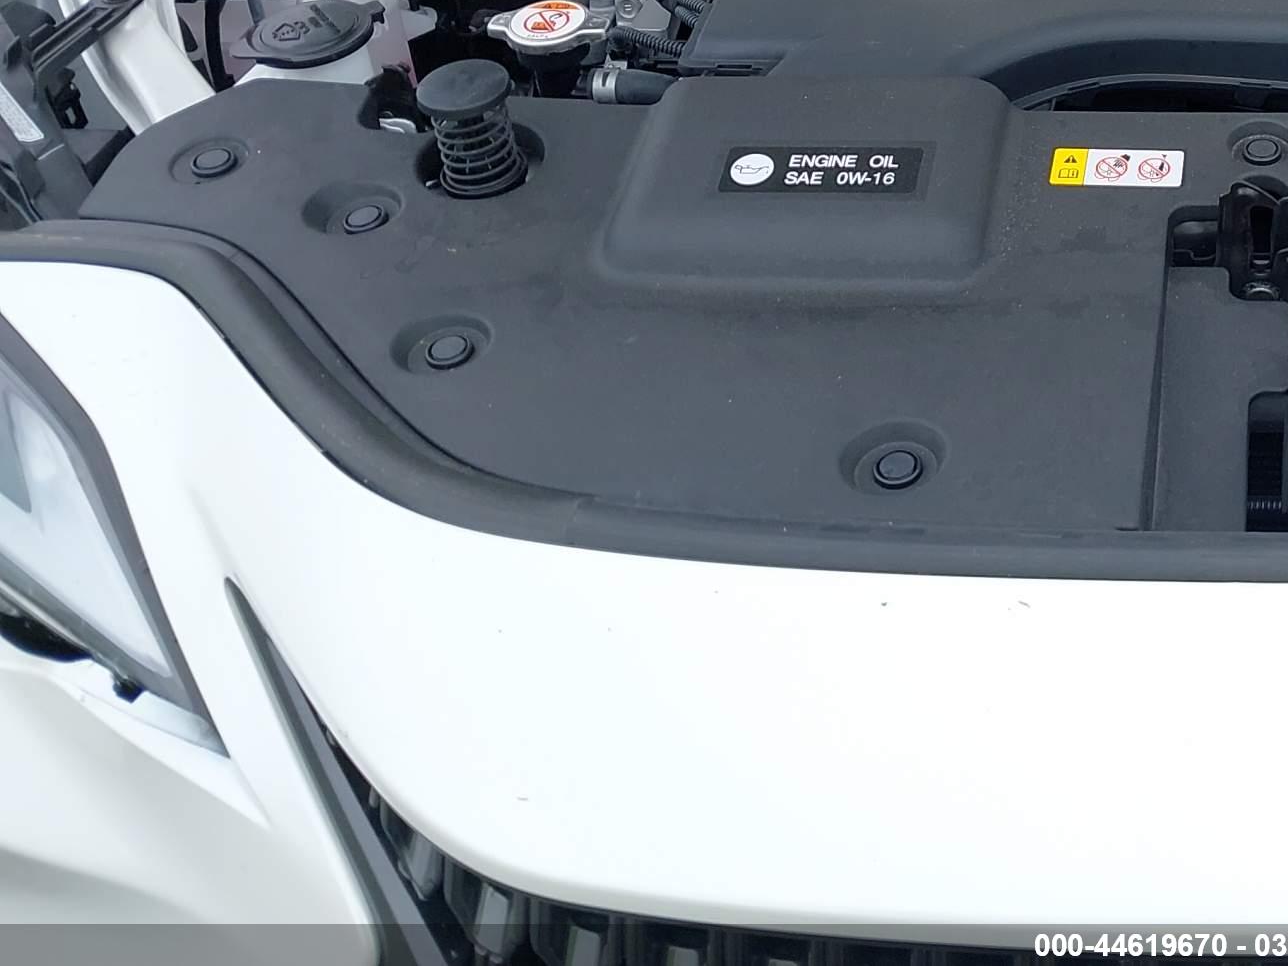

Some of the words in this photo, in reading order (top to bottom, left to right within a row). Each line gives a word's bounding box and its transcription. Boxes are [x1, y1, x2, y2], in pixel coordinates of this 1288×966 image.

[788, 154, 858, 168] ENGINE
[869, 155, 899, 168] OIL
[784, 171, 824, 185] SAE
[836, 171, 895, 185] 0W-16
